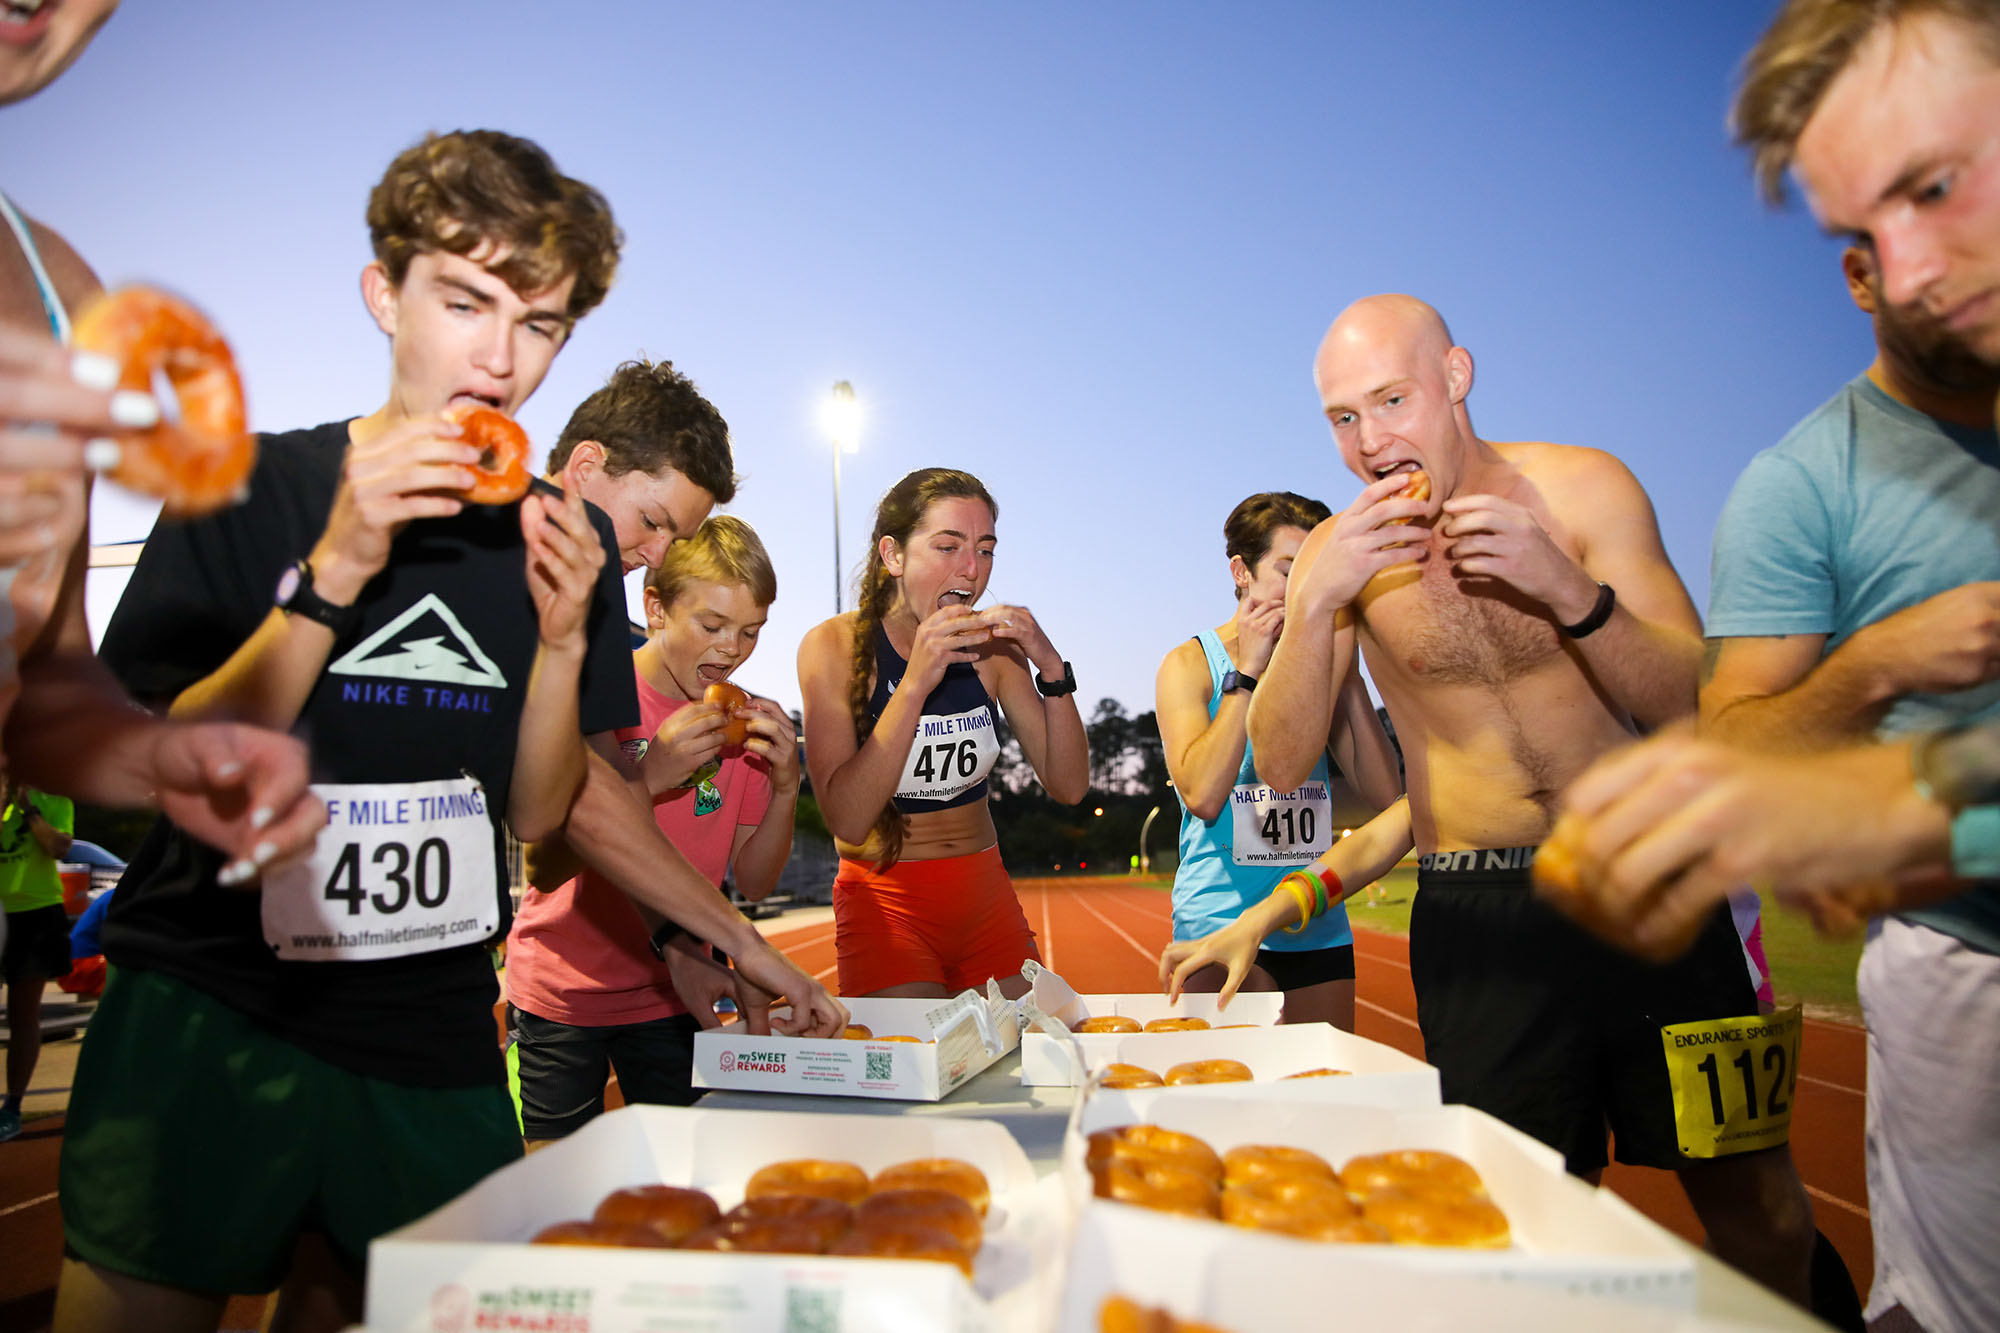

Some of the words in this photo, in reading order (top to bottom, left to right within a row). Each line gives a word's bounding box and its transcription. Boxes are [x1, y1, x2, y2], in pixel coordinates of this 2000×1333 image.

[343, 682, 410, 706] NIKE
[423, 688, 492, 713] TRAIL
[925, 720, 953, 737] MILE
[956, 713, 991, 731] TIMING
[913, 739, 978, 783] 476
[349, 799, 409, 826] MILE
[418, 791, 484, 822] TIMING
[1235, 789, 1266, 804] HALF
[1298, 786, 1327, 800] TIMING
[1261, 807, 1315, 845] 410
[325, 837, 451, 916] 430
[291, 918, 478, 949] www.halfmiletiming.com
[1674, 1029, 1744, 1048] ENDURANCE
[1746, 1022, 1786, 1041] SPORTS
[737, 1061, 787, 1074] REWARDS
[1697, 1043, 1797, 1126] 112
